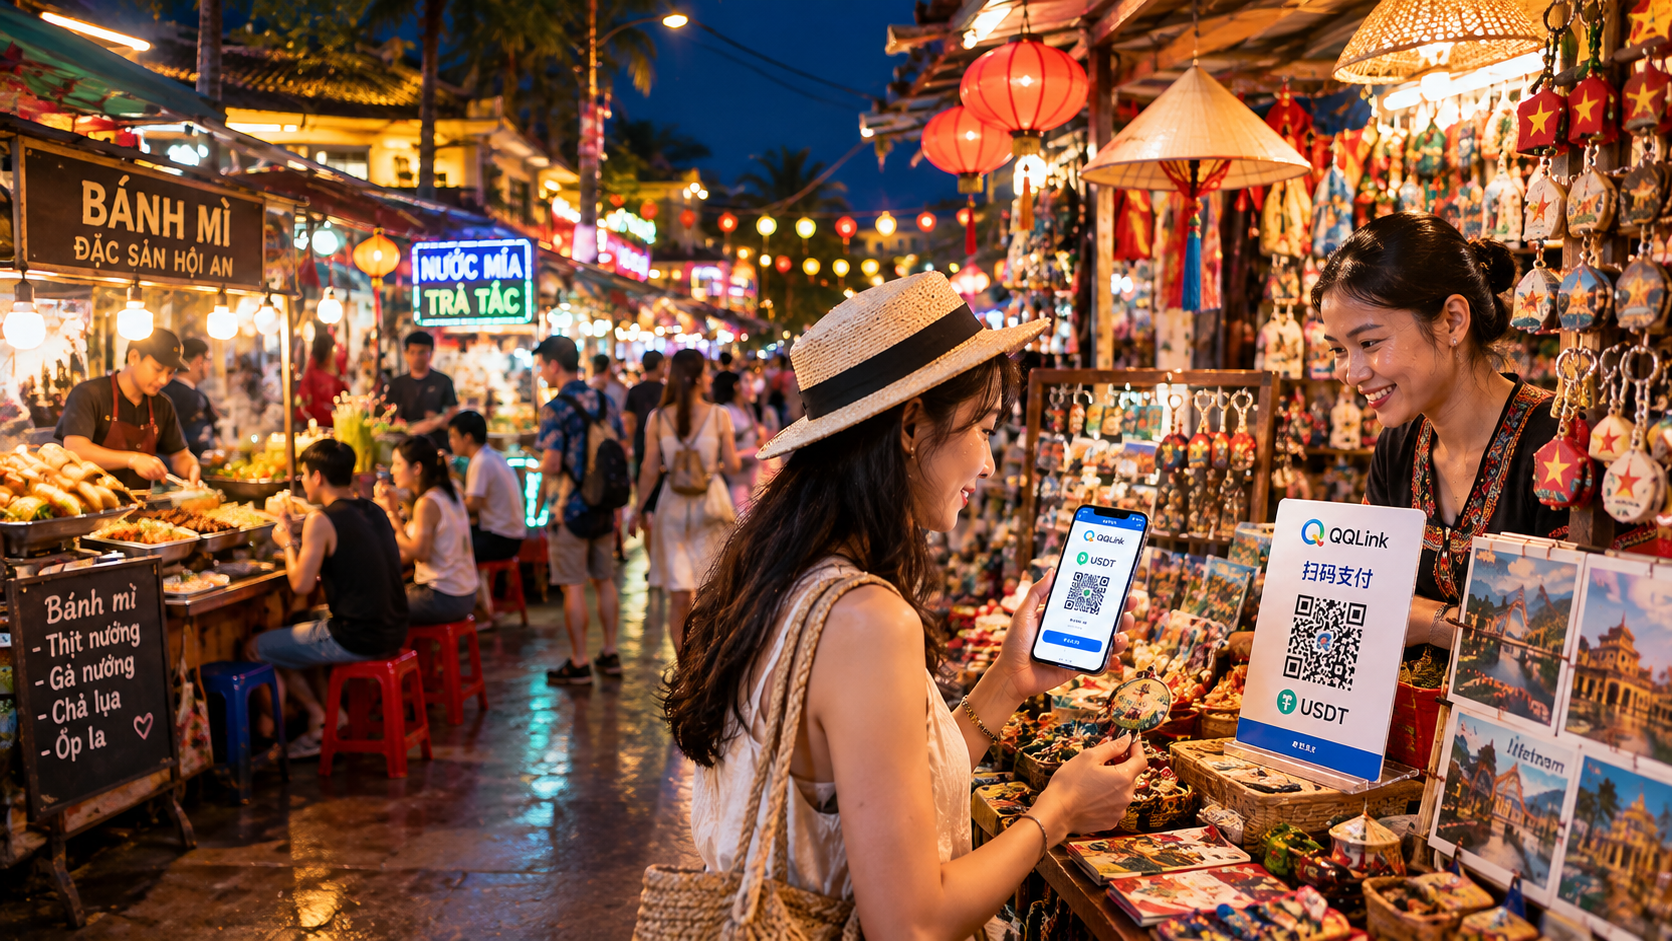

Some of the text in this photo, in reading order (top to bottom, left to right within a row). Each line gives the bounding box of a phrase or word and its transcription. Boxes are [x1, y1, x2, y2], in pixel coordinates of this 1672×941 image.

[82, 174, 231, 247] BÁNH MÌ
[73, 232, 234, 279] ĐẶC SẢN HỘI AN
[420, 246, 524, 281] NƯỚC MÍA
[1096, 533, 1125, 545] QQLink
[1329, 527, 1390, 549] QQLink
[1090, 556, 1117, 568] USDT
[1301, 560, 1374, 589] 扫码支付
[44, 588, 104, 625] Bánh
[45, 630, 84, 659] Thịt
[89, 620, 141, 648] nướng
[52, 692, 89, 724] Chả
[94, 689, 122, 717] lụa
[1300, 698, 1350, 725] USDT
[88, 725, 107, 750] la
